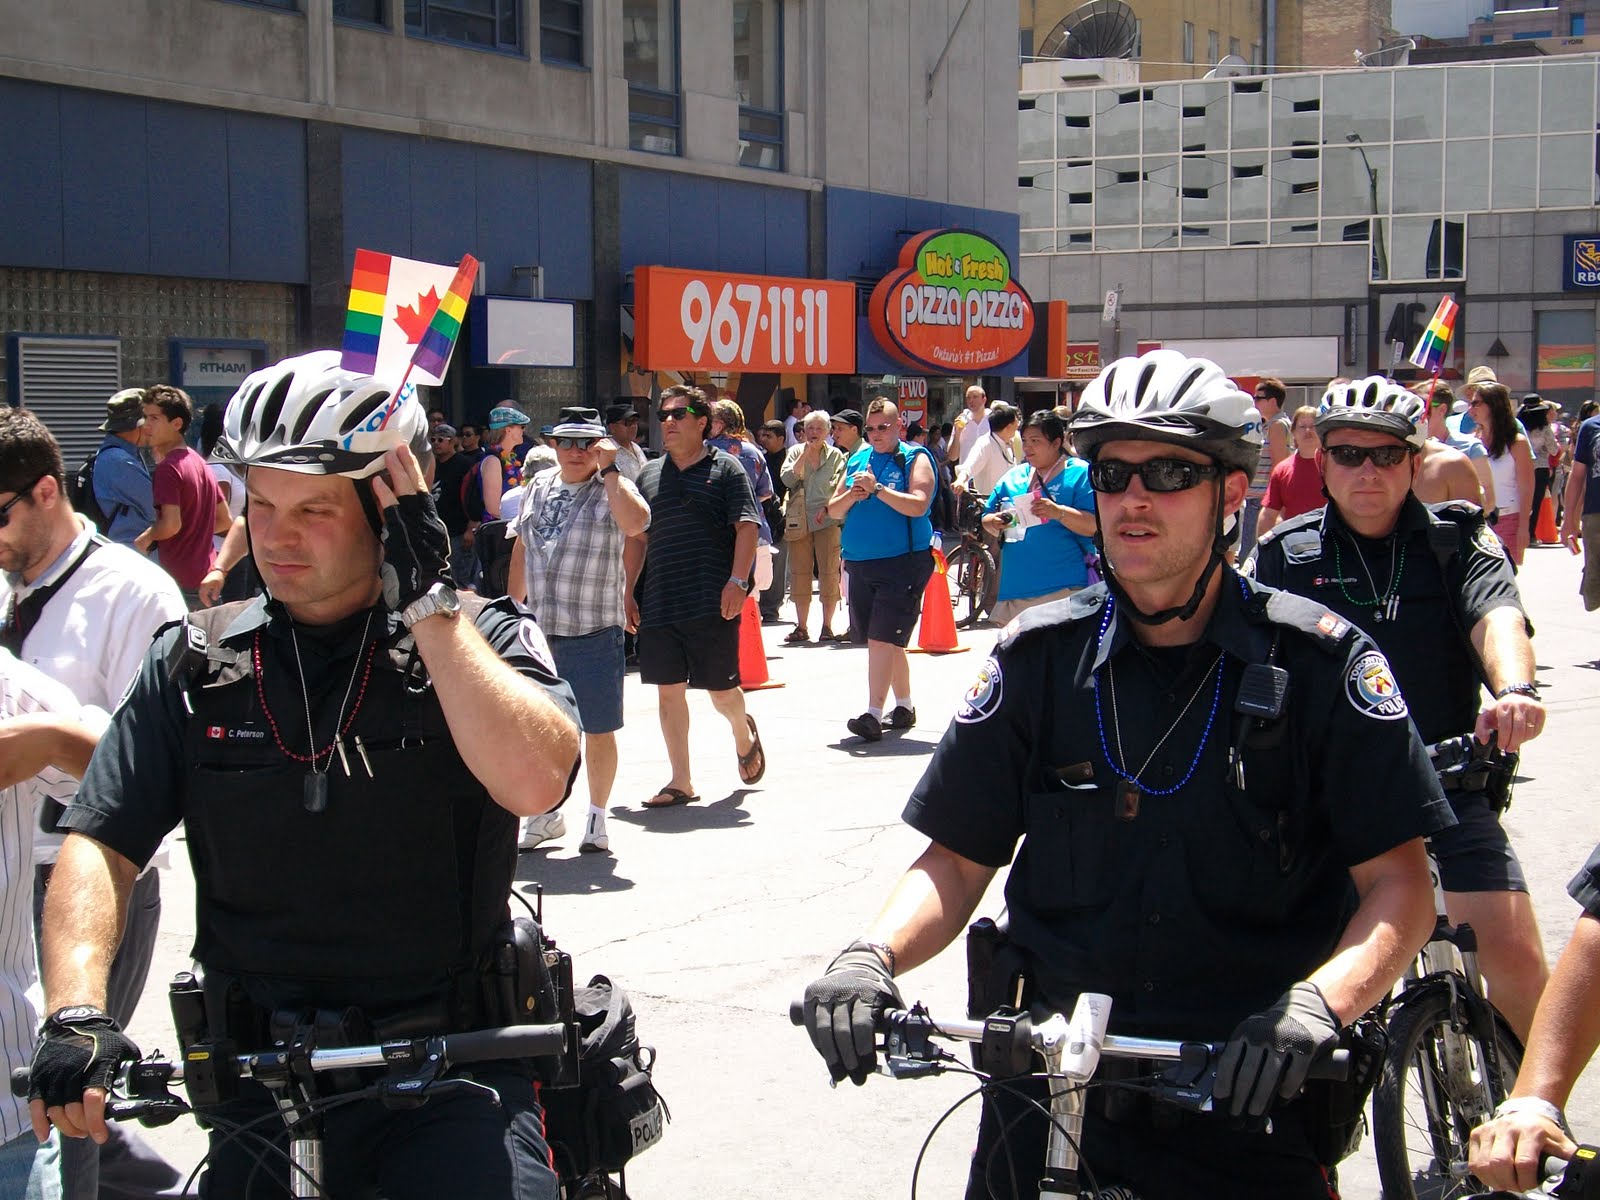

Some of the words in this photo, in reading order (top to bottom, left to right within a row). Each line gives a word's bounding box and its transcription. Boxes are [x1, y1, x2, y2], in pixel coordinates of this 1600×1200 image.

[925, 251, 953, 278] Hot
[961, 253, 1004, 283] Fresh
[933, 346, 964, 364] Ontario's
[964, 351, 975, 363] #1
[976, 347, 1000, 363] Pizza!
[899, 378, 927, 398] TWO
[236, 730, 265, 738] Peterson
